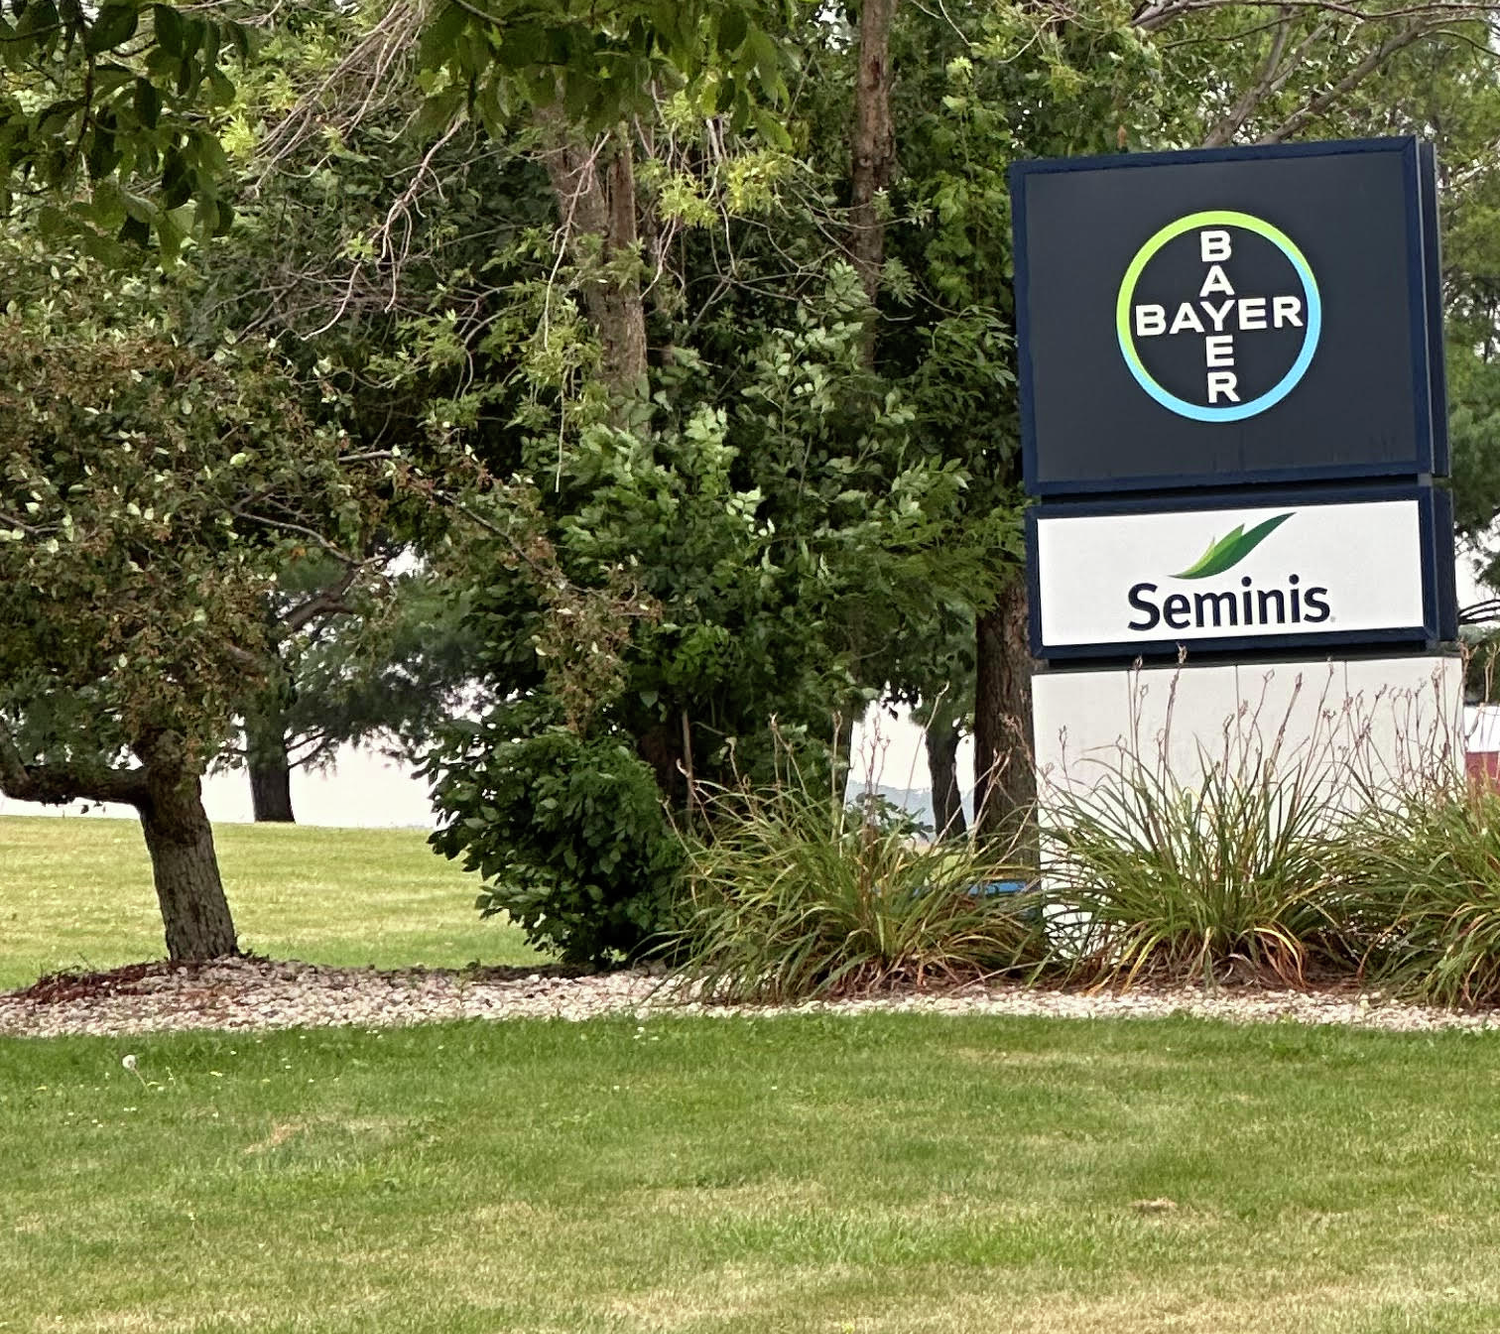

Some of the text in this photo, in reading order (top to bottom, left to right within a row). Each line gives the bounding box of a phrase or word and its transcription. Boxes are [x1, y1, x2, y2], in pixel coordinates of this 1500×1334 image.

[1135, 295, 1304, 337] BAYER
[1199, 230, 1241, 404] BAYER
[1127, 574, 1332, 632] Seminis
